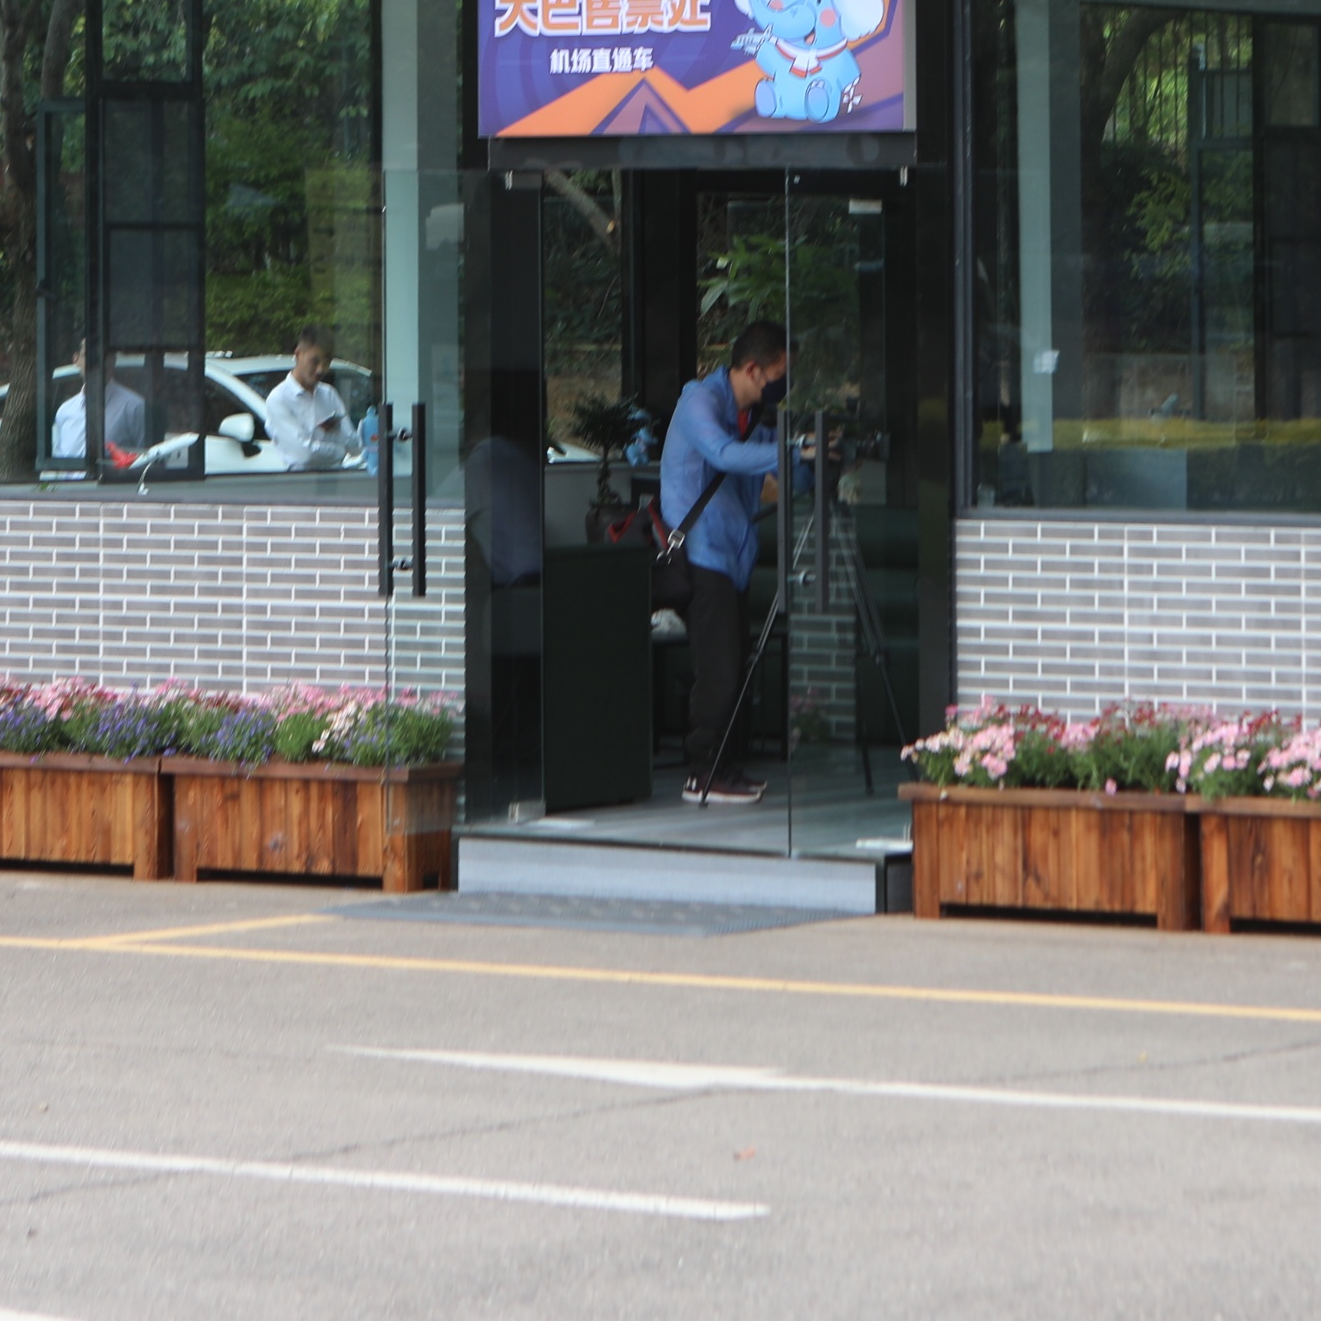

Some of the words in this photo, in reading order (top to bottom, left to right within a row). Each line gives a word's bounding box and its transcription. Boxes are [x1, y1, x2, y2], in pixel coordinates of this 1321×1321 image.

[550, 46, 654, 74] 机场直通车
